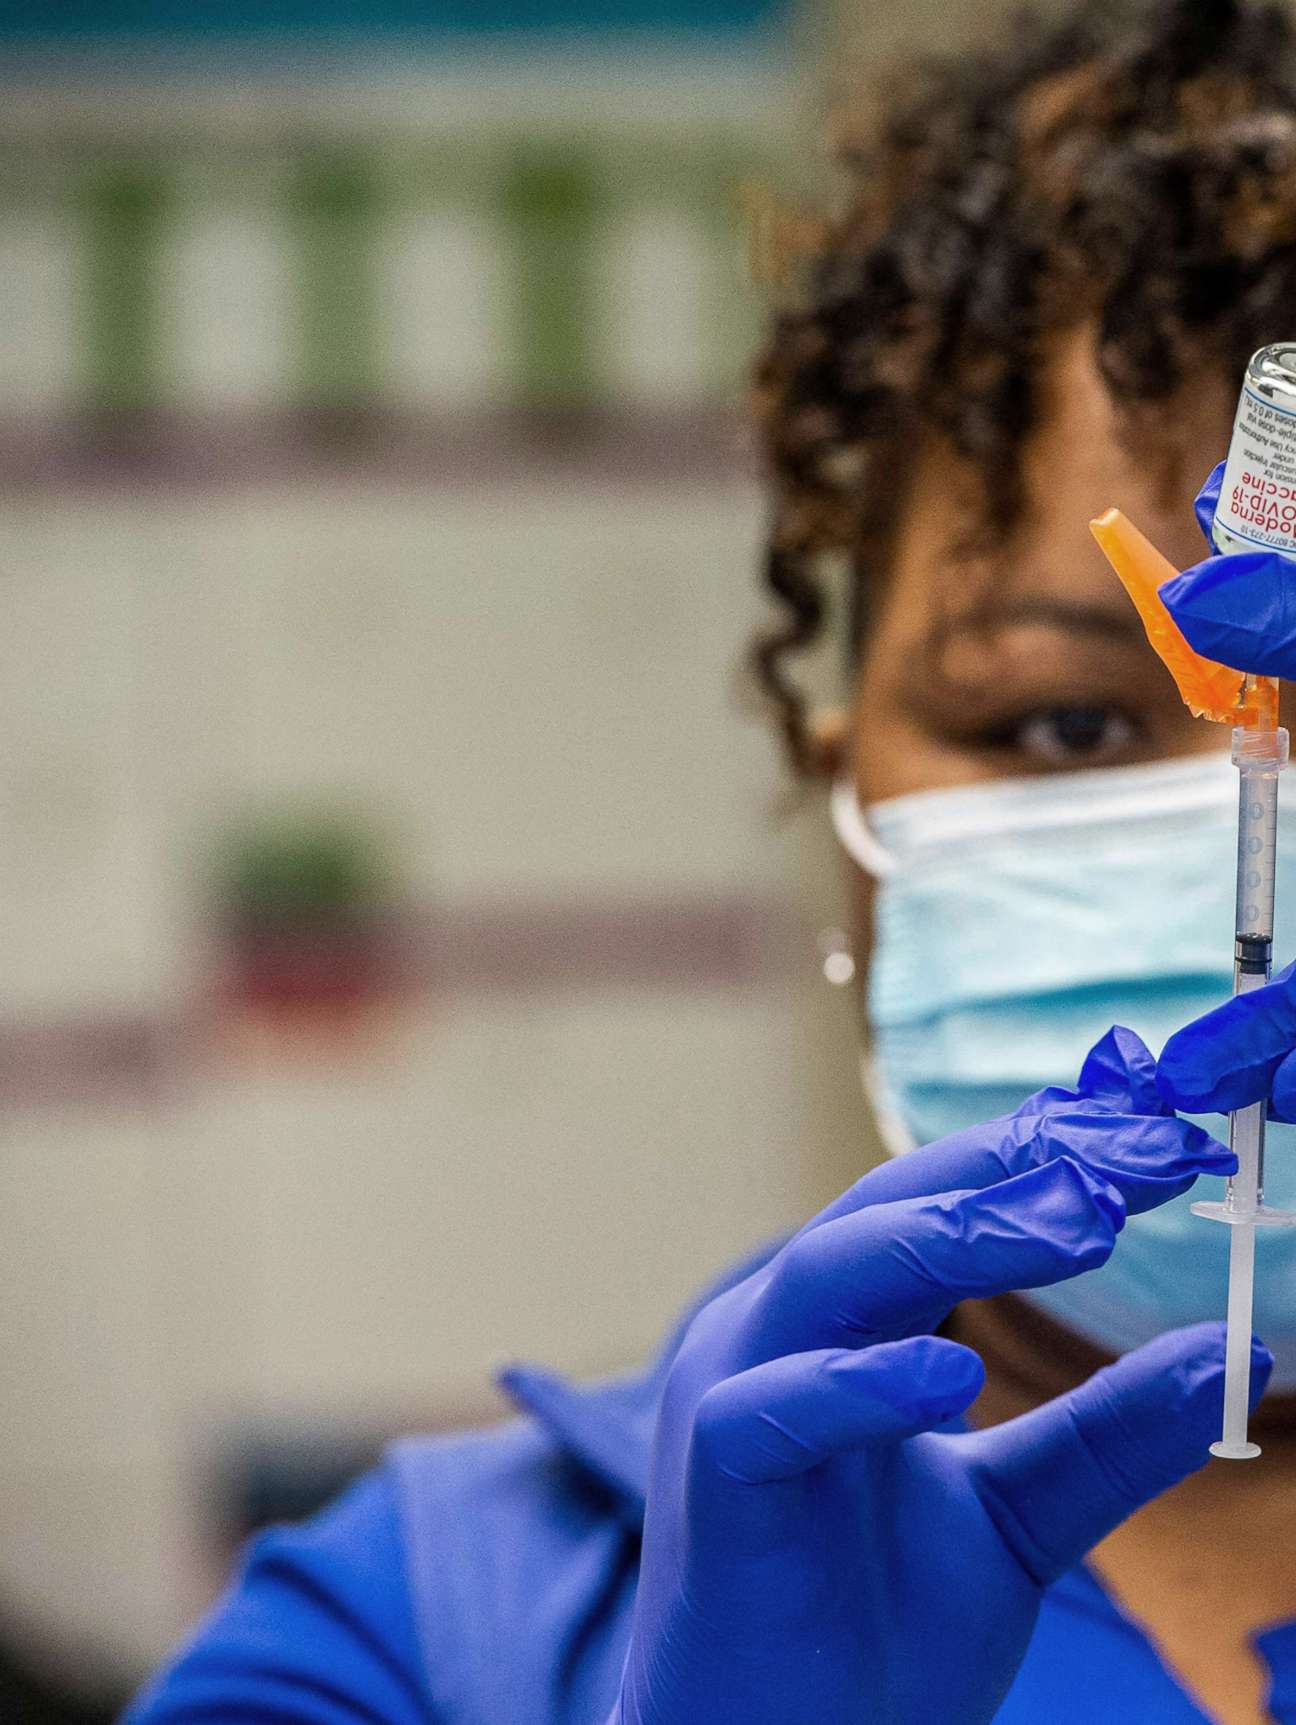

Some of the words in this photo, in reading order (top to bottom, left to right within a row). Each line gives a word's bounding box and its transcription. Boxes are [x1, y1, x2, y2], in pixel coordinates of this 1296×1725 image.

[1253, 404, 1264, 416] 0.5
[1264, 409, 1273, 419] of
[1247, 412, 1257, 424] vial
[1270, 438, 1283, 450] Use
[1273, 452, 1295, 464] under
[1263, 469, 1274, 478] for
